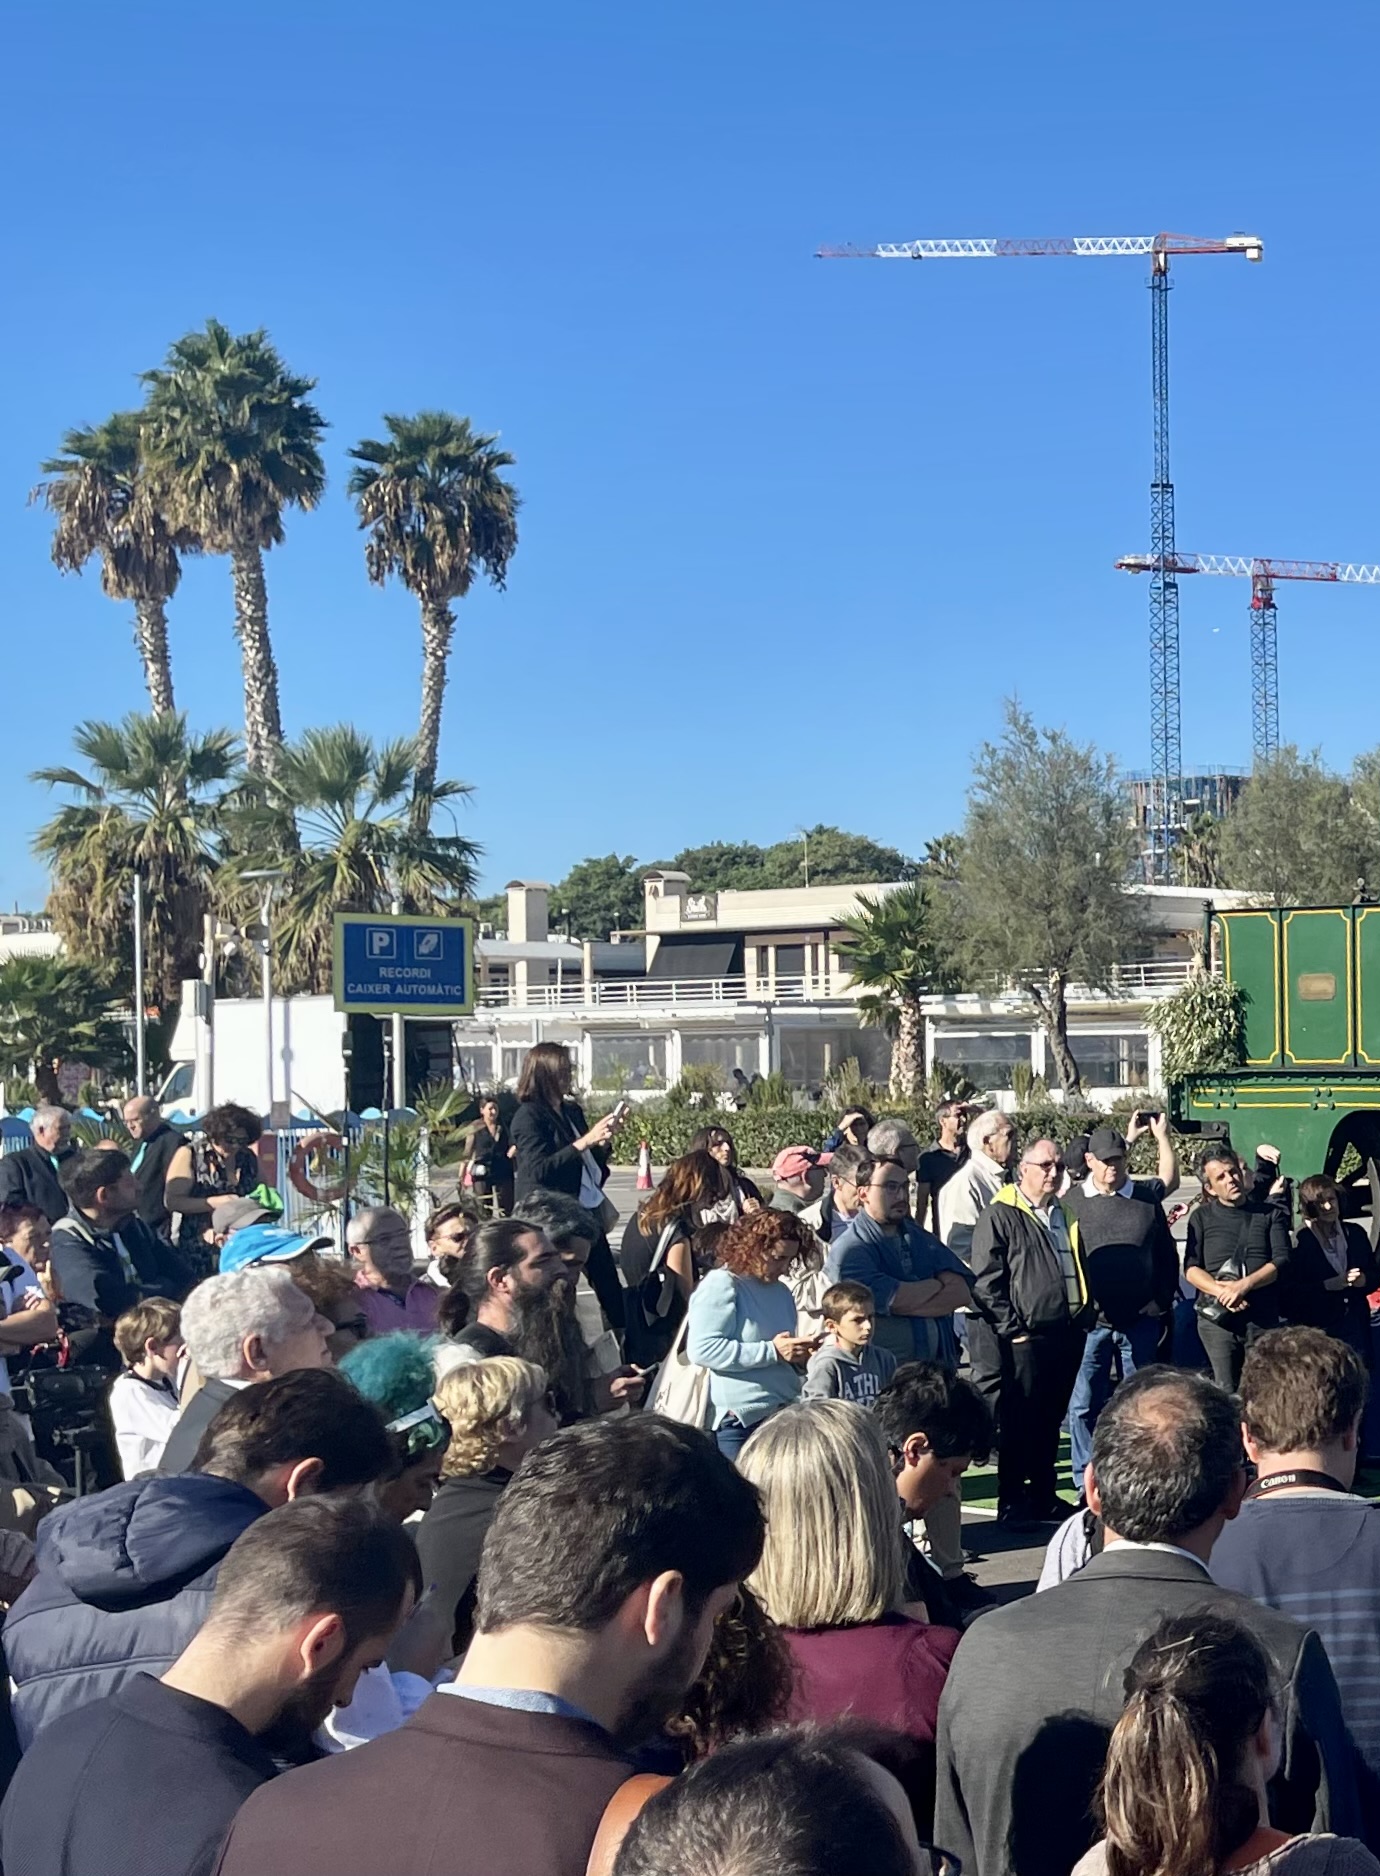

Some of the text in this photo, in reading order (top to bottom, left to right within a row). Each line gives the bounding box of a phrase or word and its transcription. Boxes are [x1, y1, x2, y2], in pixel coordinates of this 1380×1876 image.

[372, 931, 391, 955] P
[379, 966, 431, 979] RECORDI
[347, 982, 462, 996] CAIXER AUTOMÀTIC
[1260, 1473, 1297, 1489] Canon
